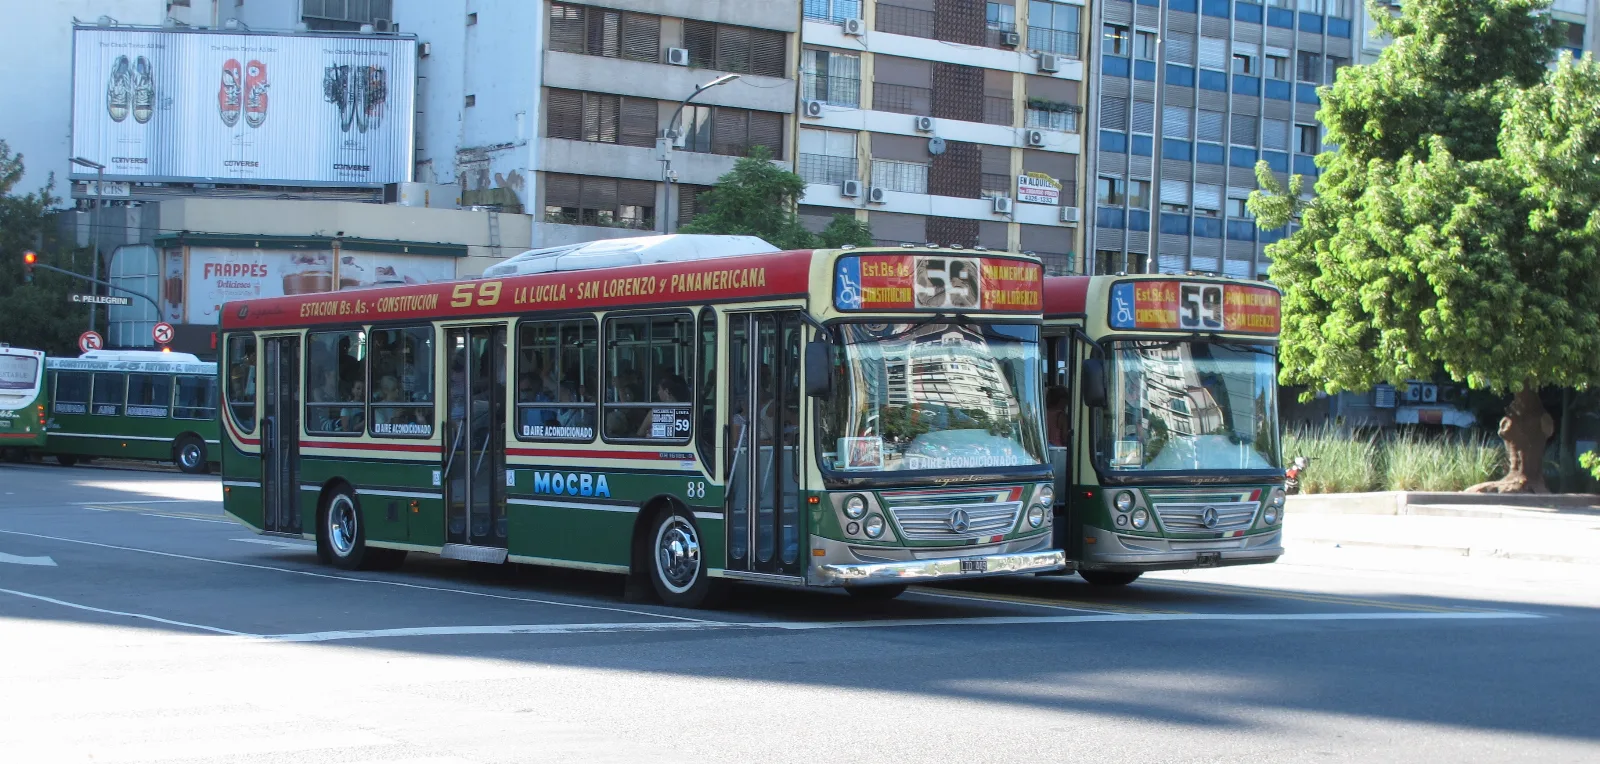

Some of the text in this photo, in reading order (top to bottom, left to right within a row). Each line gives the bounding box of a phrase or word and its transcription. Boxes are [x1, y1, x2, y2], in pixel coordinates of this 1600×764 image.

[104, 186, 123, 194] CBS
[1020, 177, 1027, 185] EN
[1029, 178, 1056, 188] ALQUILE
[983, 265, 1038, 281] PANAMERICANA
[514, 287, 527, 304] LA
[530, 284, 566, 302] LUCILA
[577, 281, 600, 299] SAN
[603, 276, 656, 298] LORENZO
[670, 267, 766, 293] PANAMERICANA
[916, 258, 978, 308] 59
[73, 294, 128, 305] C. PELLEGRINI
[450, 281, 503, 308] 59
[862, 287, 911, 303] CONSTITUCION
[991, 290, 1006, 304] SAN
[1007, 290, 1038, 305] LORENZO
[300, 302, 337, 318] ESTACION
[339, 301, 353, 315] Bs.
[354, 301, 369, 314] As.
[377, 294, 438, 312] CONSTITUCION
[1181, 285, 1222, 328] 59
[380, 423, 432, 434] AIRE ACONDICIONADO
[530, 425, 593, 438] AIRE ACONDICIONADO
[675, 419, 690, 432] 59
[920, 454, 1018, 469] AIRE ACONDICIONADO
[534, 471, 610, 498] MOCBA
[687, 481, 705, 498] 88
